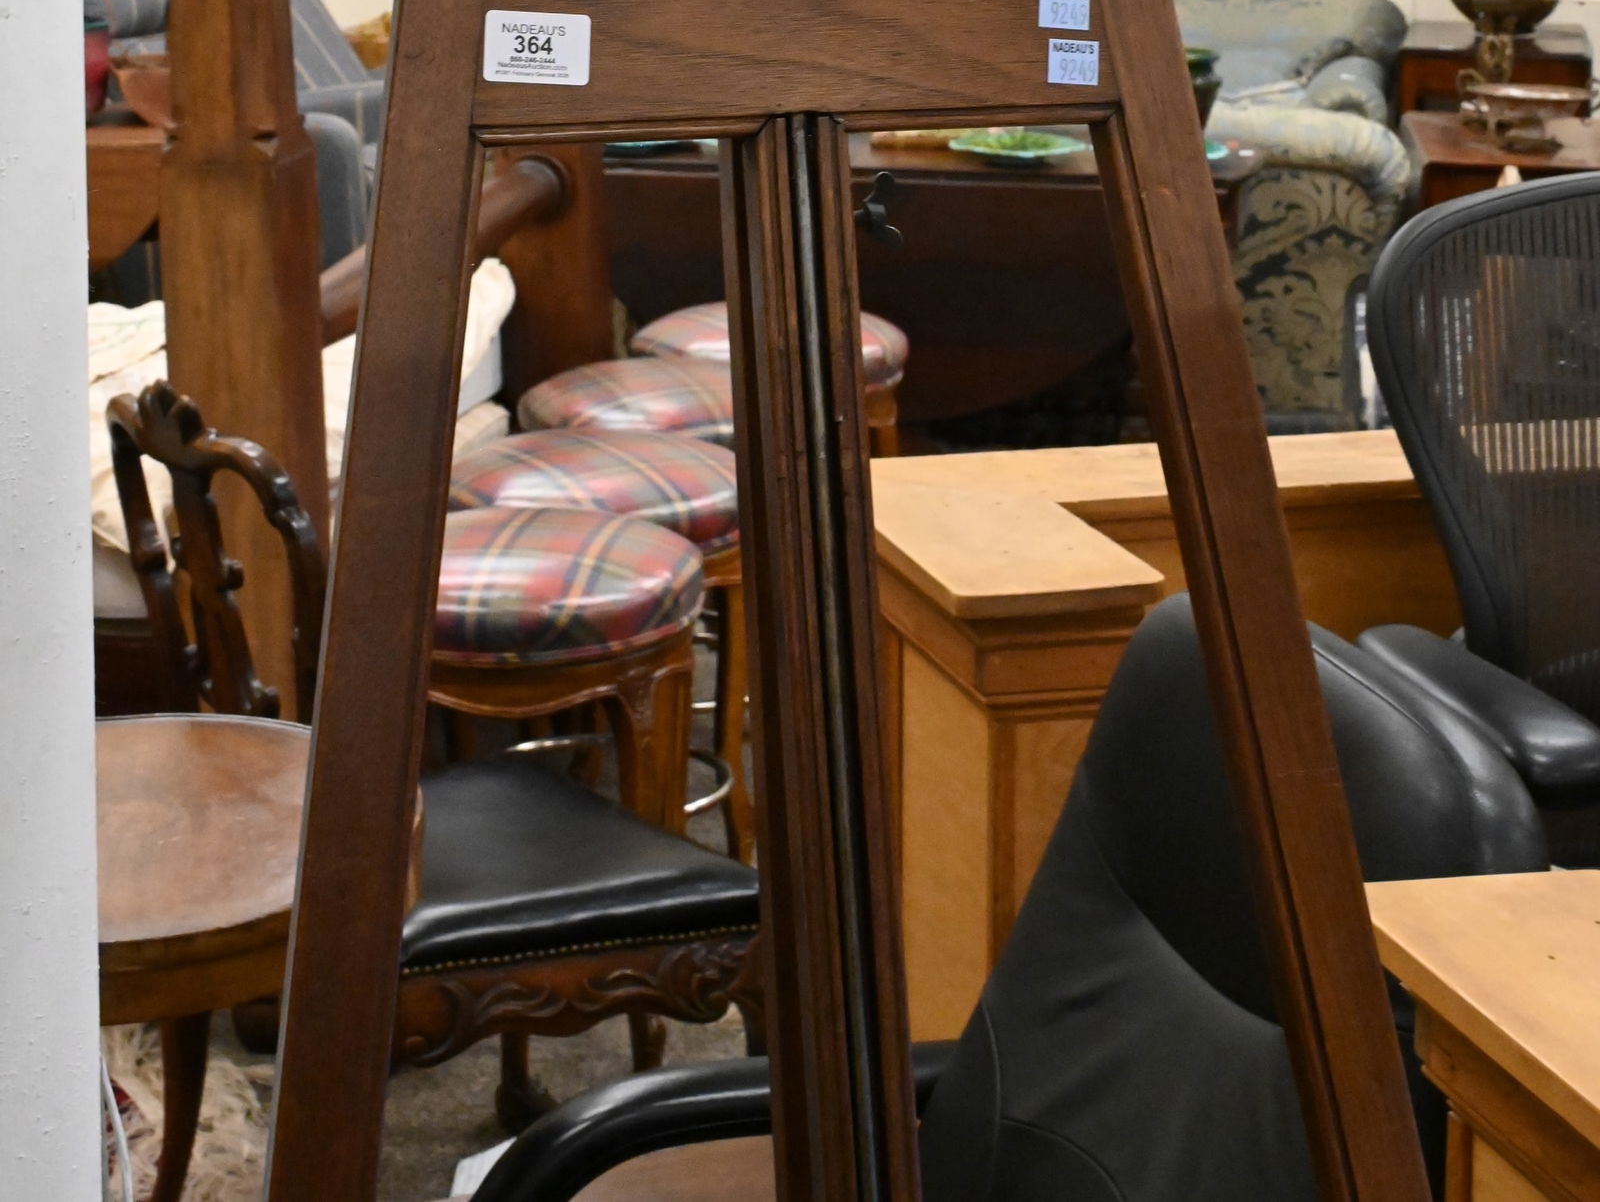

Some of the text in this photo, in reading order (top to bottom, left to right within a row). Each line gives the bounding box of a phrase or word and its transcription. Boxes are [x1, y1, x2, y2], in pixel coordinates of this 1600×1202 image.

[502, 23, 566, 36] NADEAU'S
[514, 35, 553, 55] 364
[1053, 42, 1095, 54] NADEAU'S
